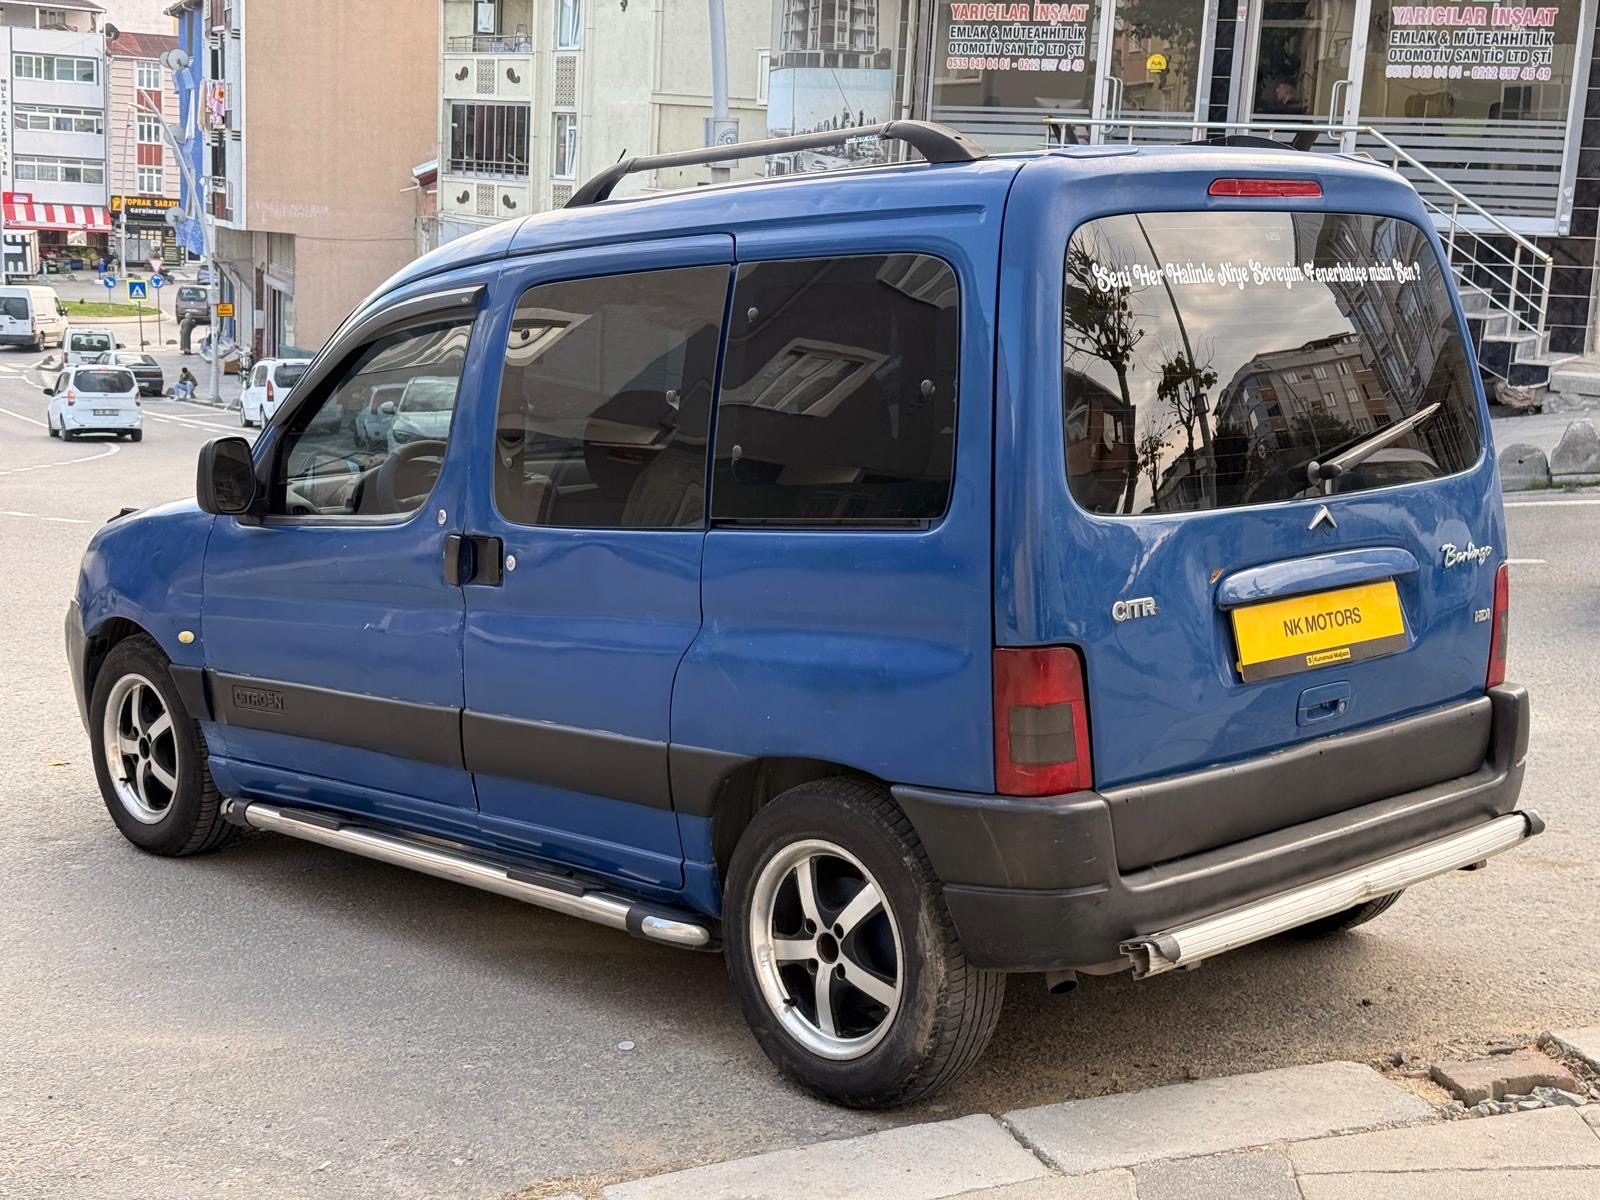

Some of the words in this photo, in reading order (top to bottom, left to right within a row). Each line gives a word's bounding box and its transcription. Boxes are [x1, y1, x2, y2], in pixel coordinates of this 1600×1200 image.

[950, 3, 1029, 21] YARICILAR
[1033, 0, 1089, 25] İNŞAAT
[1392, 6, 1487, 26] YARICILAR
[1491, 3, 1558, 30] İNŞAAT
[949, 25, 989, 40] EMLAK
[990, 26, 1000, 40] &
[1002, 23, 1087, 40] MÜTEAHHİTLİK
[1389, 30, 1436, 46] EMLAK
[1438, 31, 1449, 46] &
[1453, 28, 1554, 47] MÜTEAHHİTLİK
[948, 39, 1002, 55] OTOMOTİV
[1004, 43, 1025, 55] SAN
[1027, 40, 1045, 56] TİC
[1046, 43, 1066, 56] LTD
[1067, 42, 1085, 59] ŞTİ
[1388, 47, 1452, 63] OTOMOTİV
[1455, 50, 1480, 63] SAN
[1483, 47, 1503, 63] TİC
[1506, 50, 1529, 64] LTD
[1531, 48, 1552, 67] ŞTİ
[1471, 66, 1497, 80] 0212
[1499, 67, 1519, 80] 597
[1536, 67, 1551, 80] 49
[125, 198, 152, 207] TOPRAK
[154, 200, 179, 208] SARAYI
[129, 207, 168, 215] GAYRİMENK
[1092, 262, 1132, 292] Seni
[1132, 263, 1164, 286] Her
[1166, 259, 1215, 285] Halinle
[1217, 260, 1249, 290] Niye
[1248, 259, 1304, 289] Seveyim
[1304, 260, 1368, 287] Fenerbahçe
[1368, 260, 1395, 282] misin
[1440, 541, 1492, 568] Berlingo
[1112, 596, 1157, 622] CITR
[1283, 617, 1304, 637] NK
[1305, 607, 1362, 633] MOTORS
